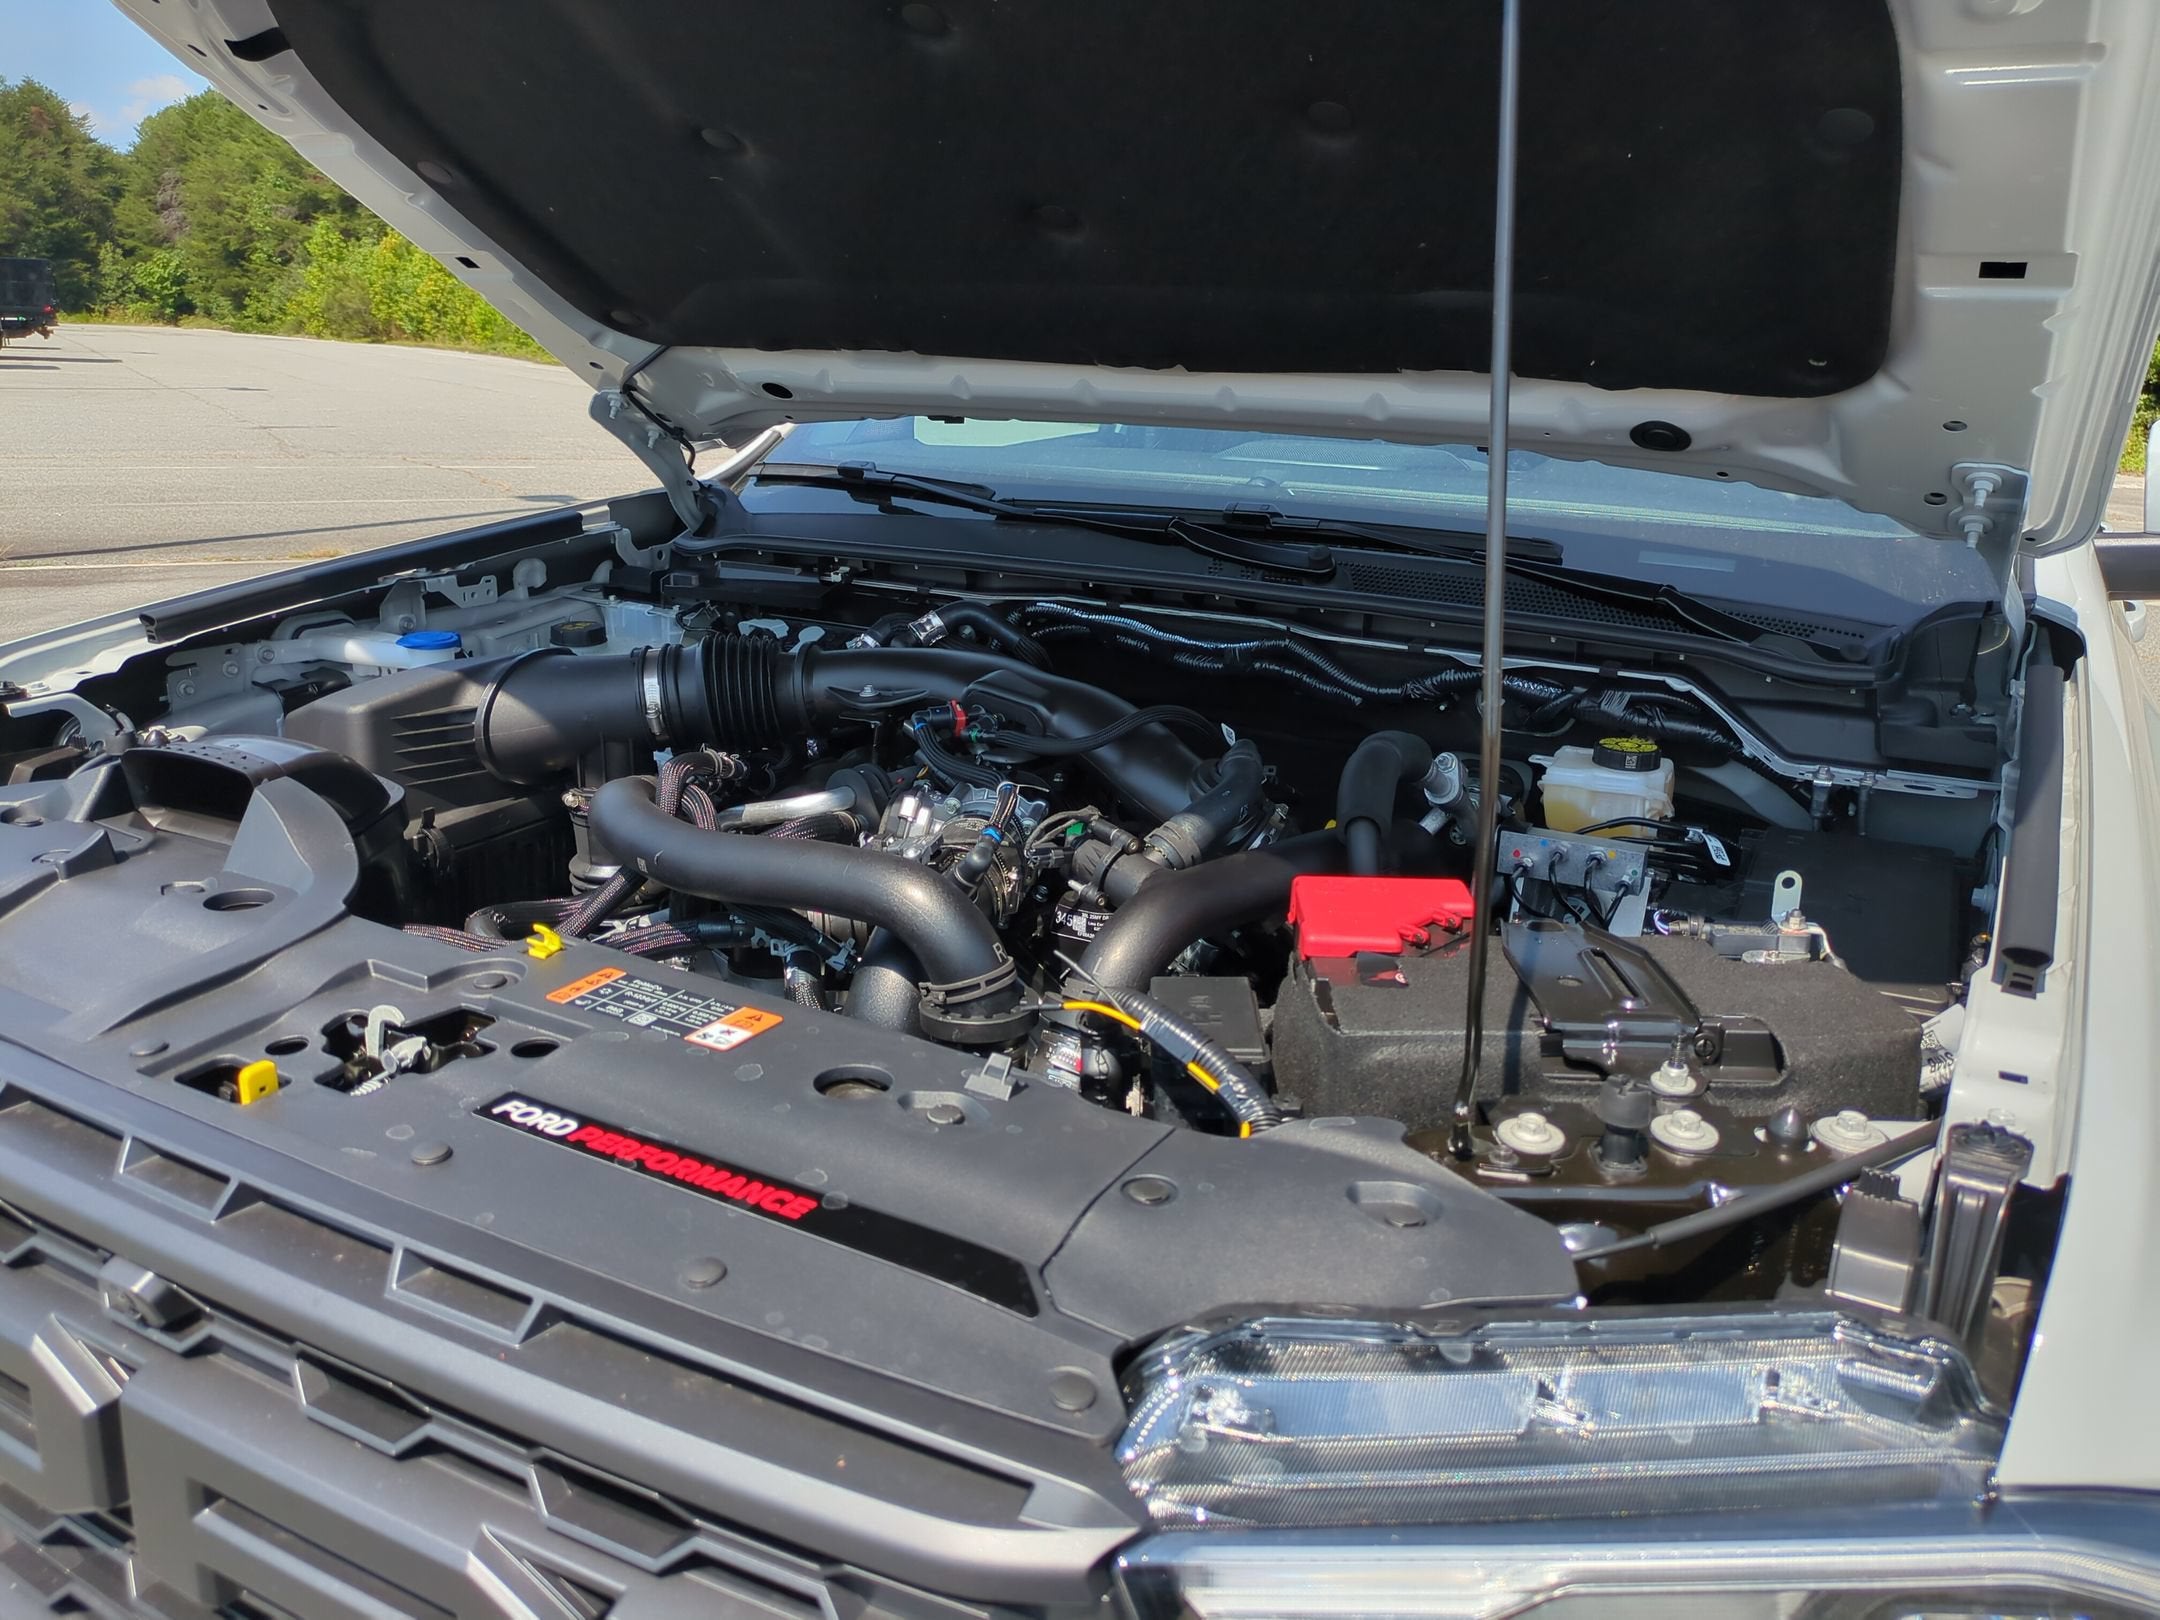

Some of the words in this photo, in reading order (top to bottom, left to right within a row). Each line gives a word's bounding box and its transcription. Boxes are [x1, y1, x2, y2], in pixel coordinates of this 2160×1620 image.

[1055, 911, 1073, 927] 345
[992, 942, 1008, 963] R
[492, 1099, 578, 1137] FORD
[567, 1124, 818, 1220] PERFORMANCE
